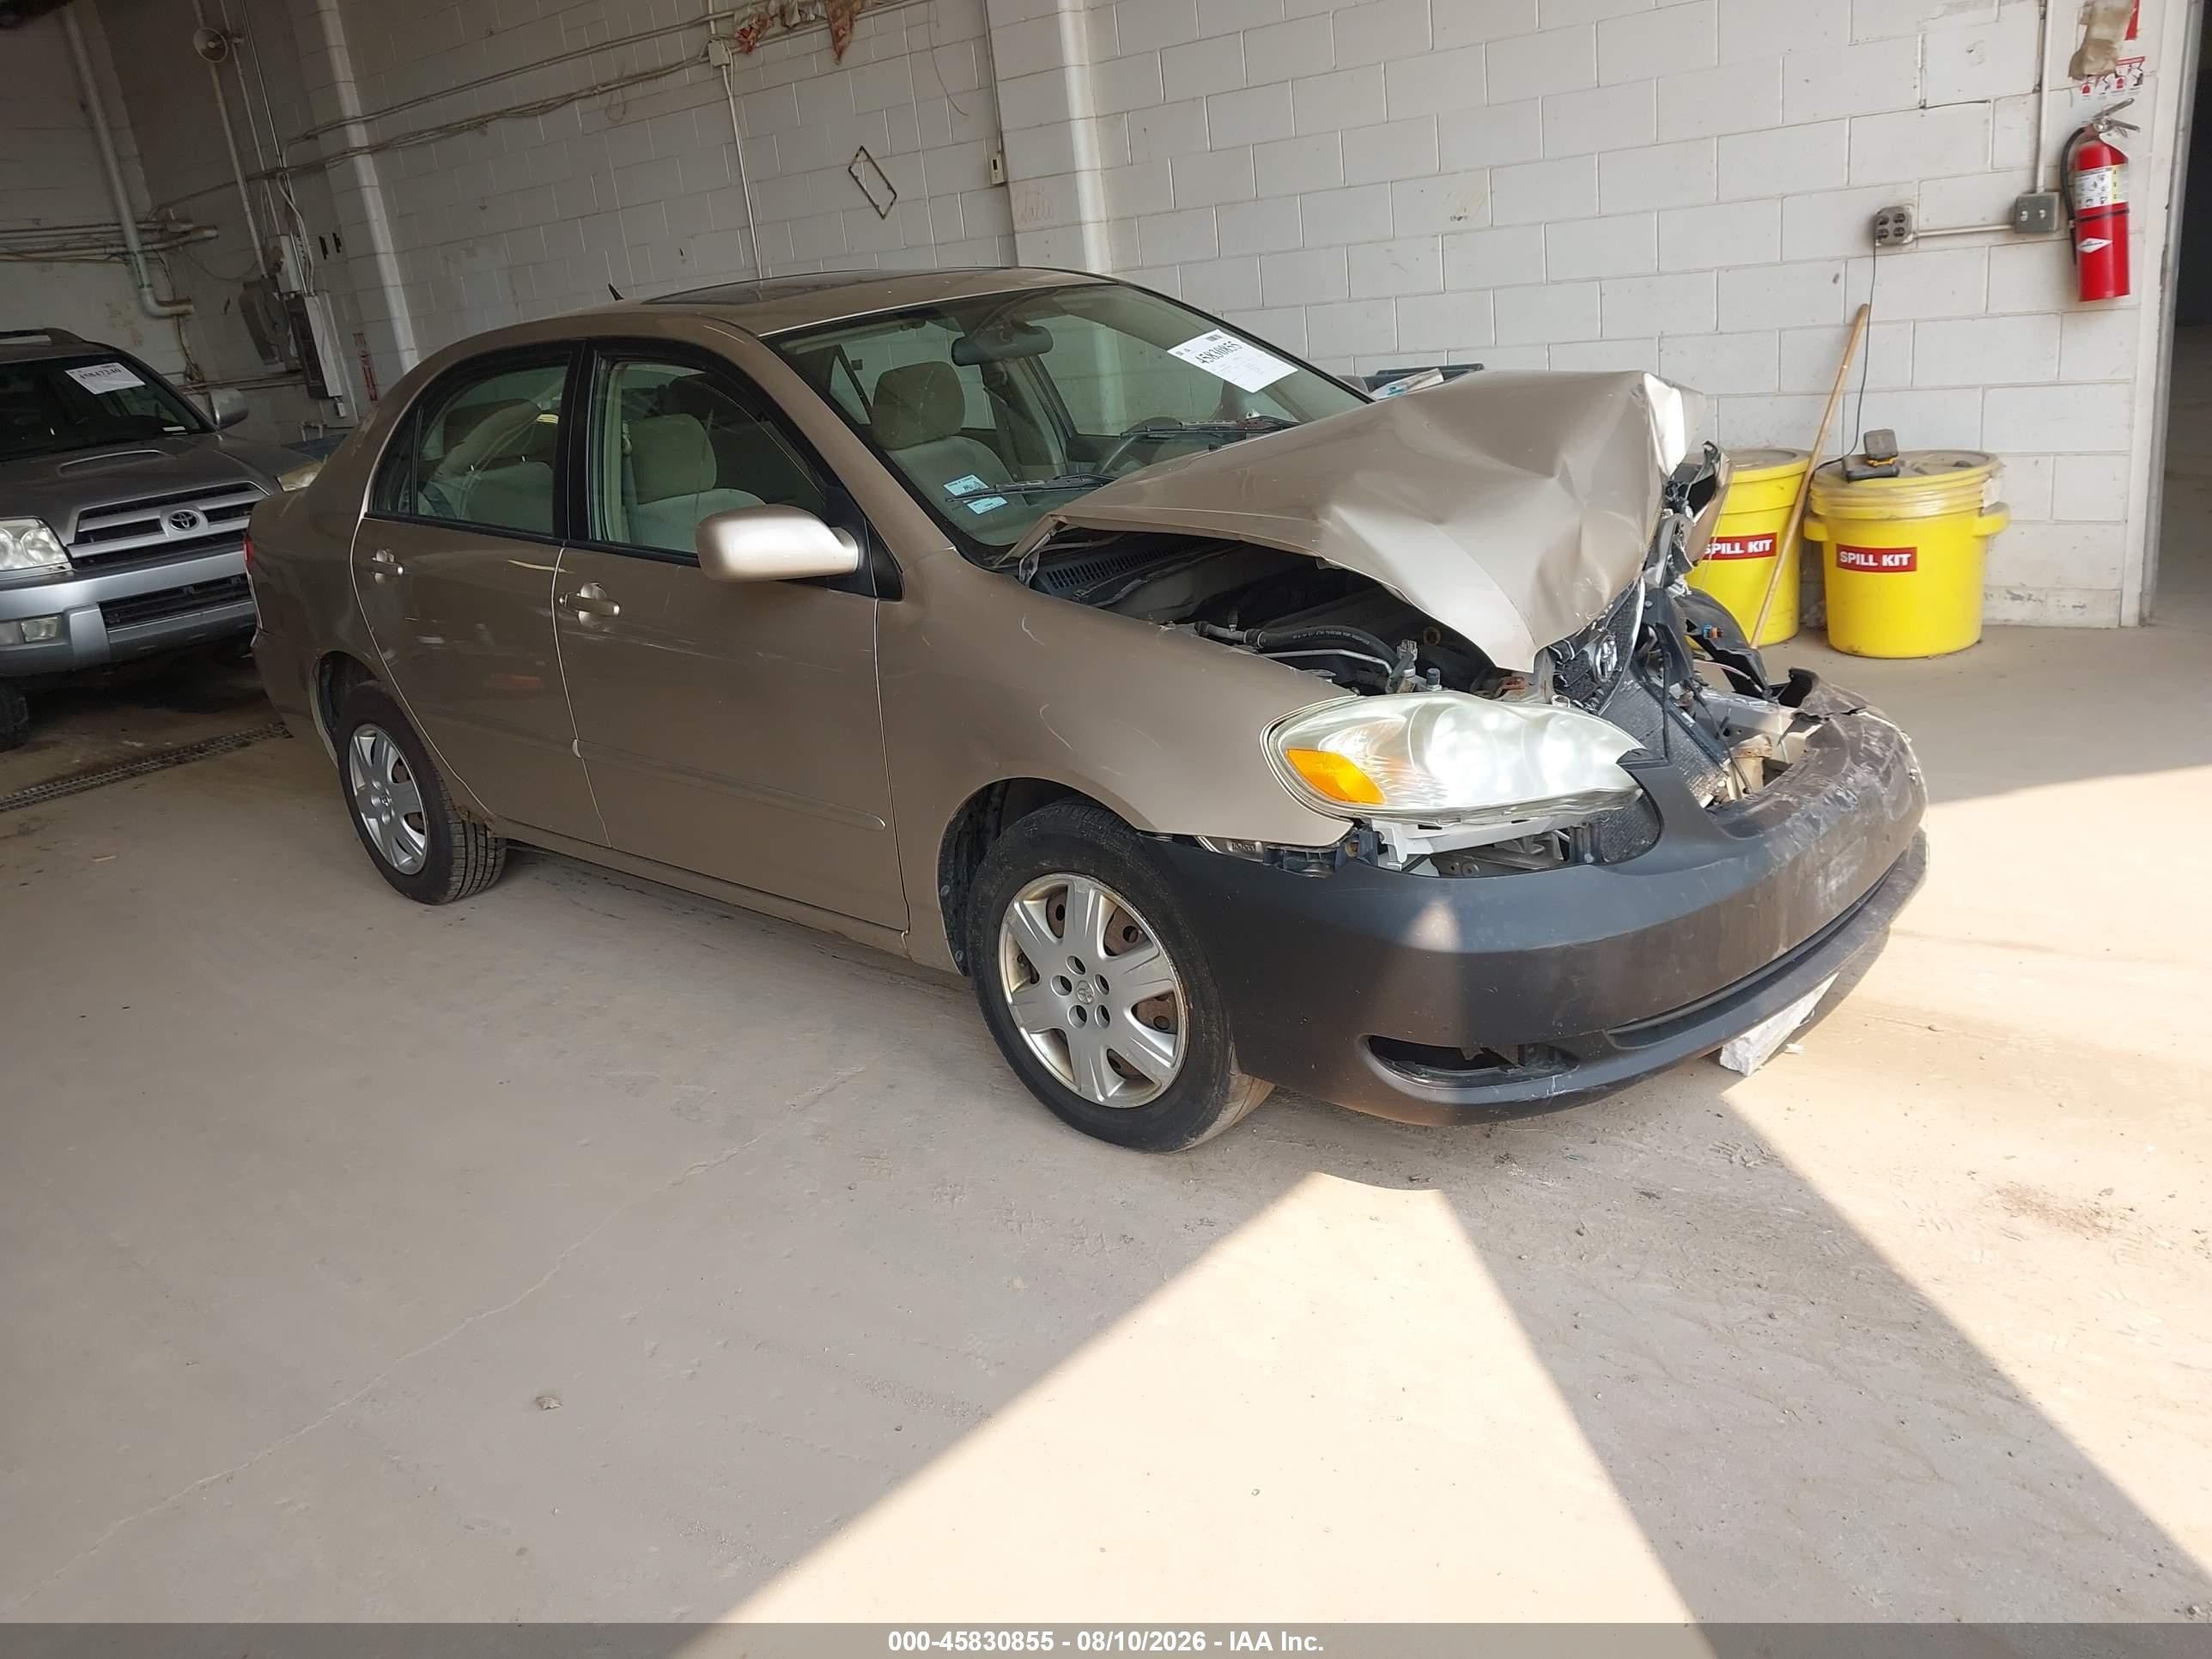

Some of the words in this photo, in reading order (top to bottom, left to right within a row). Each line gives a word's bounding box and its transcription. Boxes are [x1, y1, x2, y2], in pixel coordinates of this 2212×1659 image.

[1194, 340, 1243, 364] 45830855
[1705, 542, 1745, 555] SPILL
[1748, 538, 1773, 554] KIT
[1840, 550, 1879, 567] SPILL
[1881, 553, 1912, 567] KIT
